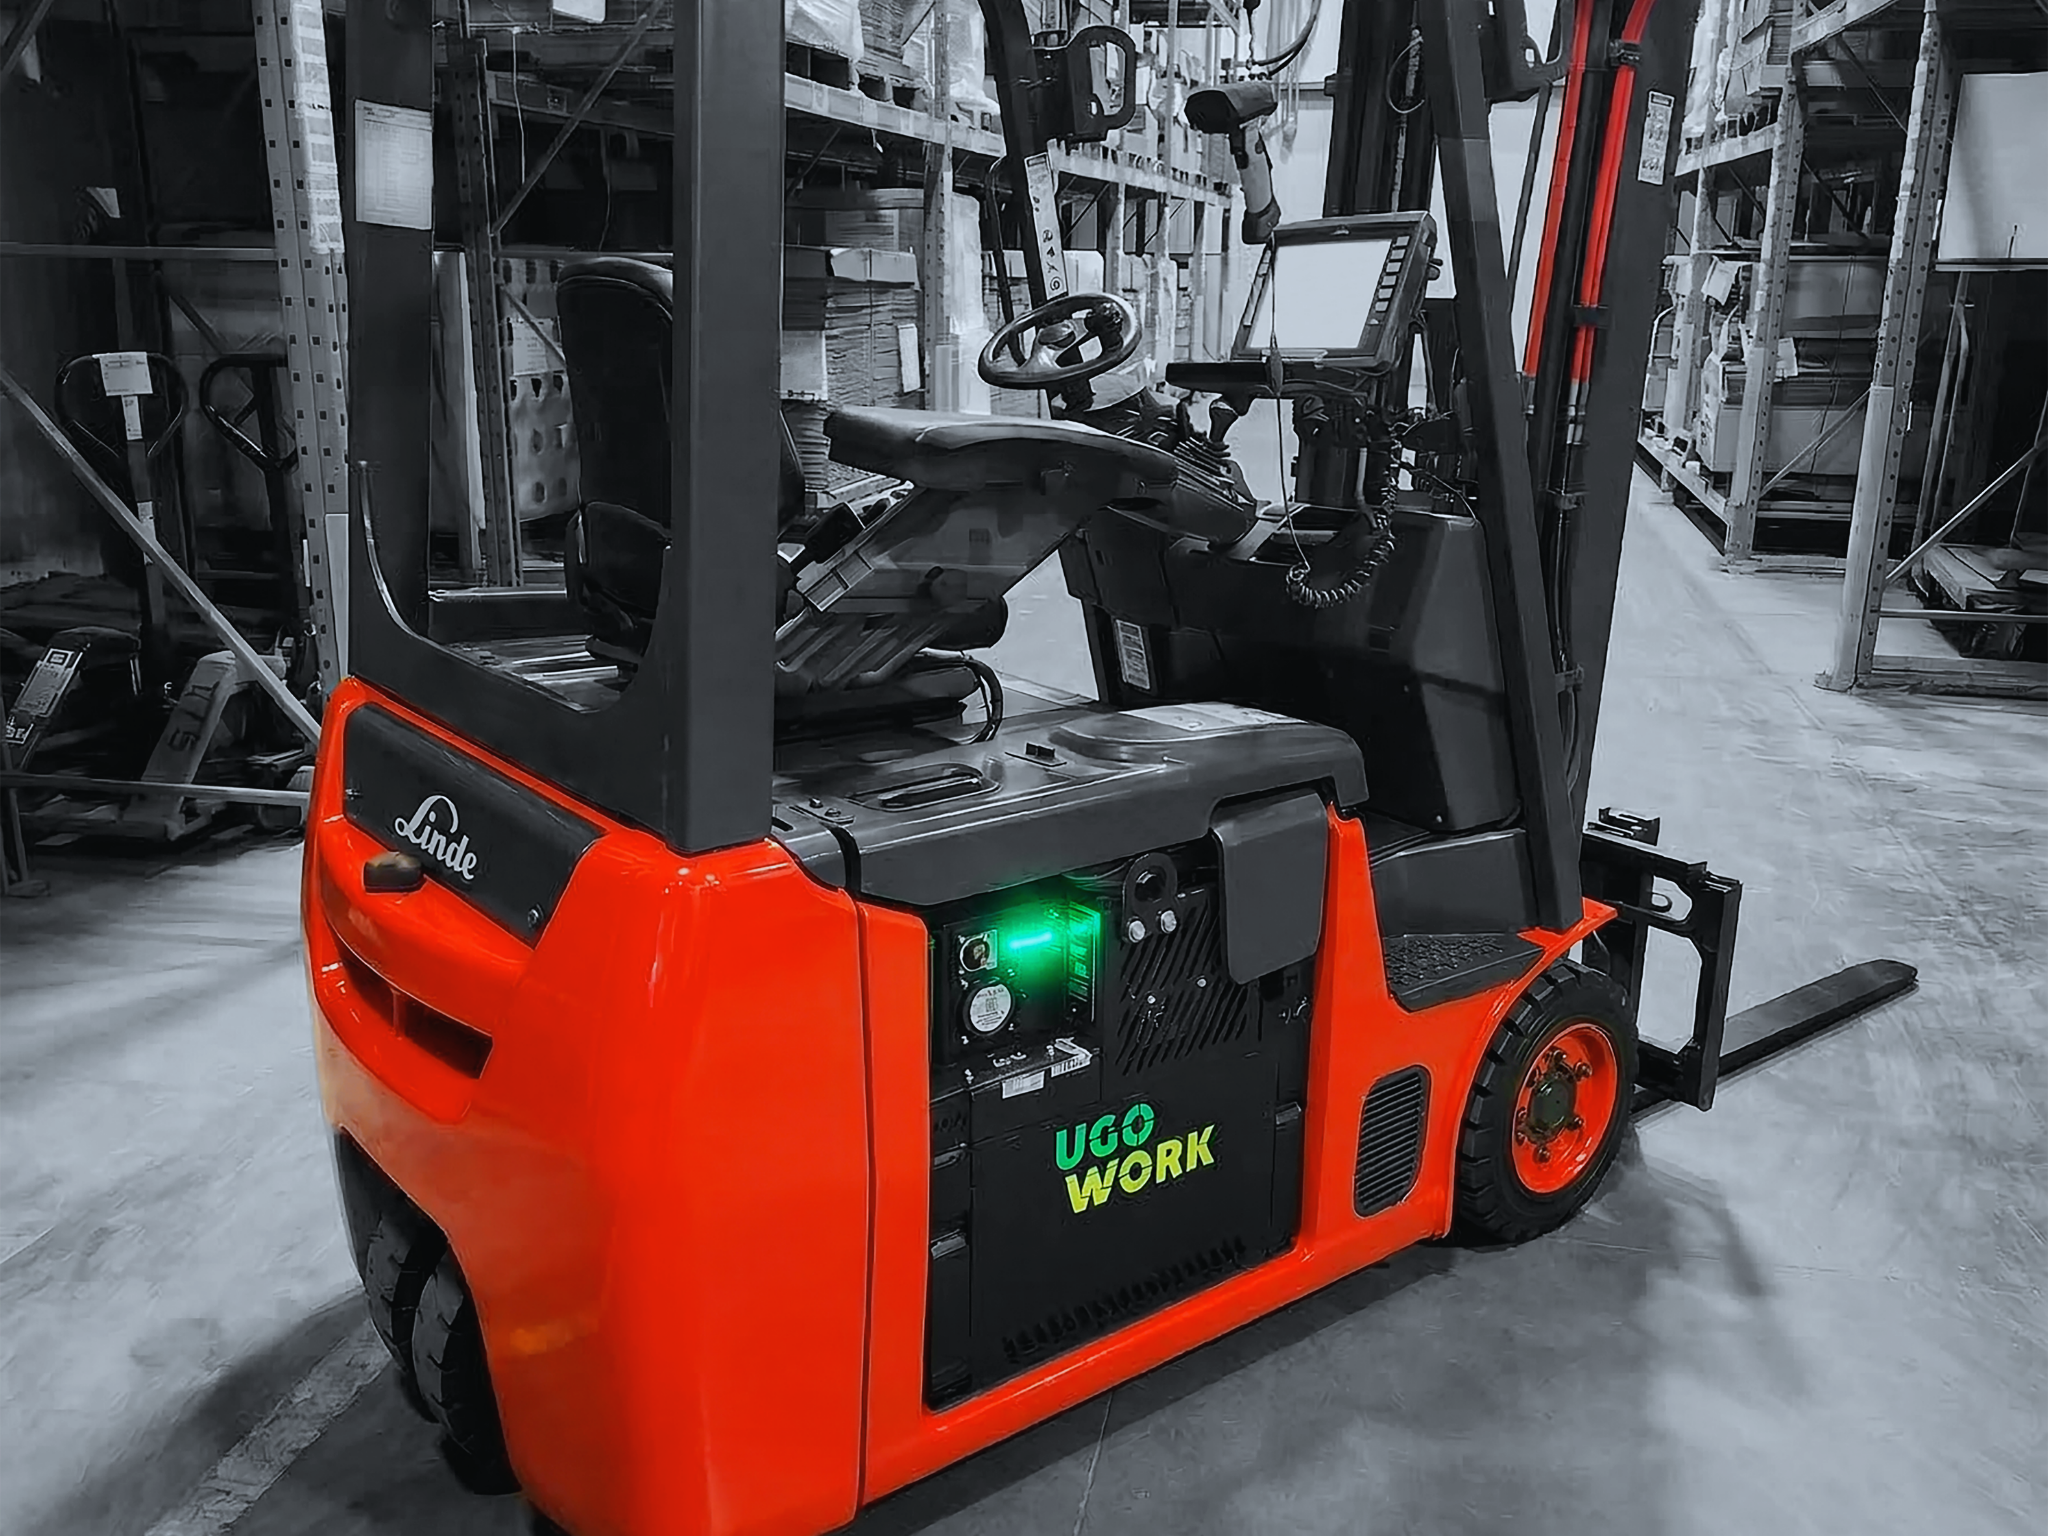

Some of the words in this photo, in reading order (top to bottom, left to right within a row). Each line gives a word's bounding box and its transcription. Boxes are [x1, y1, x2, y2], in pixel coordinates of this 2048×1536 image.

[394, 794, 477, 880] Linde
[1055, 1103, 1155, 1171] UGO
[1064, 1124, 1216, 1214] WORK
